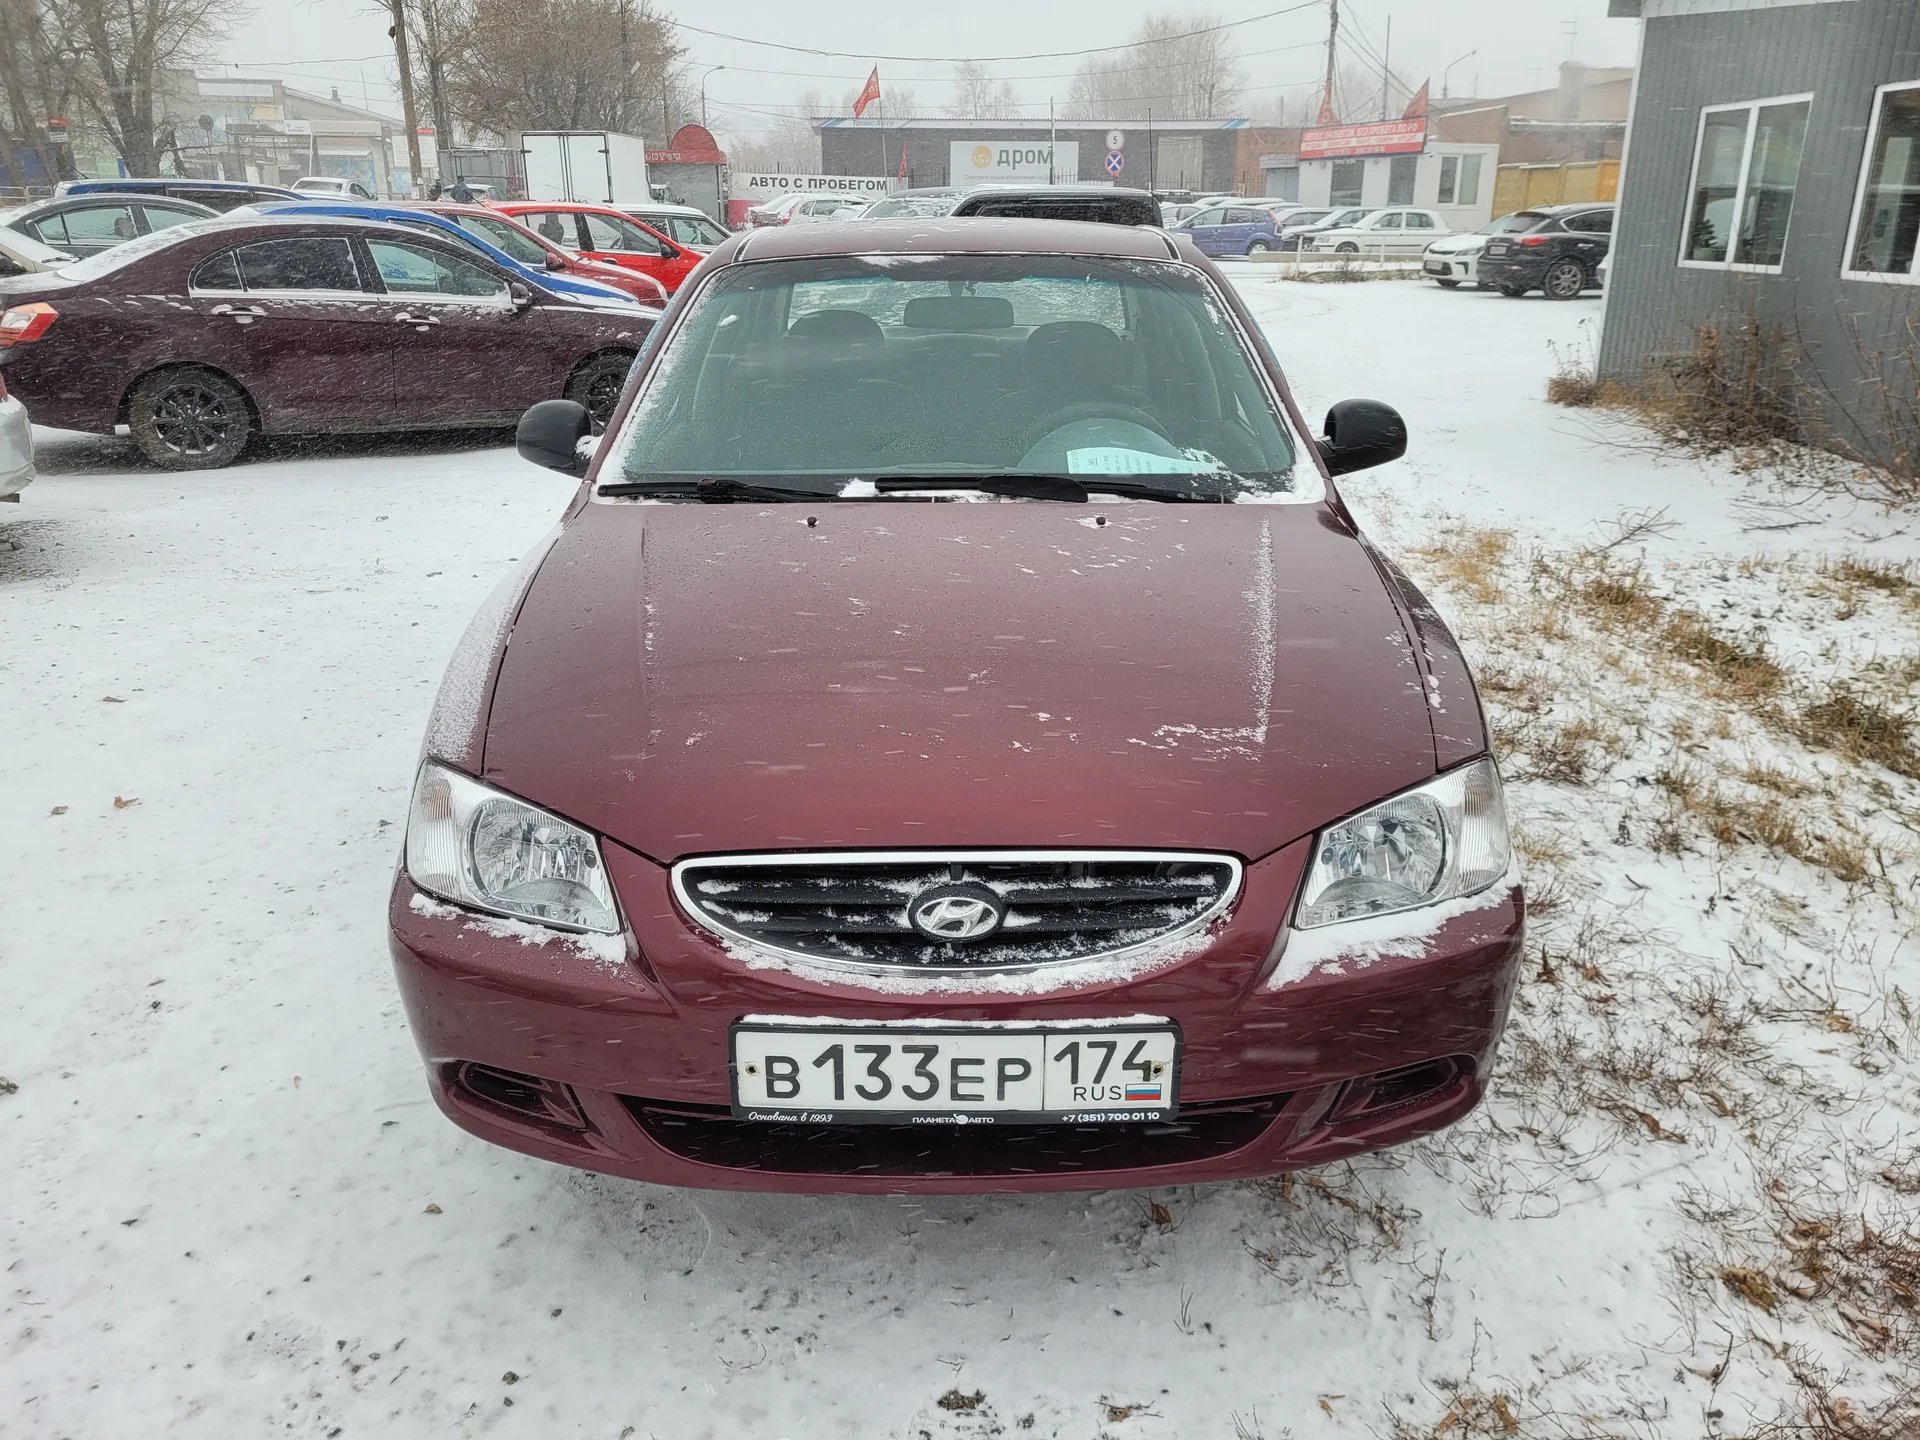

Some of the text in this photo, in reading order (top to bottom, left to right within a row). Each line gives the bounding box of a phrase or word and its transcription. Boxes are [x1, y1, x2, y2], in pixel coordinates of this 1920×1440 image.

[1112, 135, 1119, 145] 5
[996, 149, 1052, 170] дром
[749, 176, 887, 191] АВТО С ПРОБЕГОМ
[1053, 1040, 1152, 1085] 174
[1073, 1086, 1123, 1102] RUS
[748, 1112, 798, 1123] Основана
[808, 1113, 833, 1124] 1993
[1061, 1115, 1076, 1123] +7
[1076, 1114, 1105, 1124] (351)
[1107, 1113, 1132, 1122] 700
